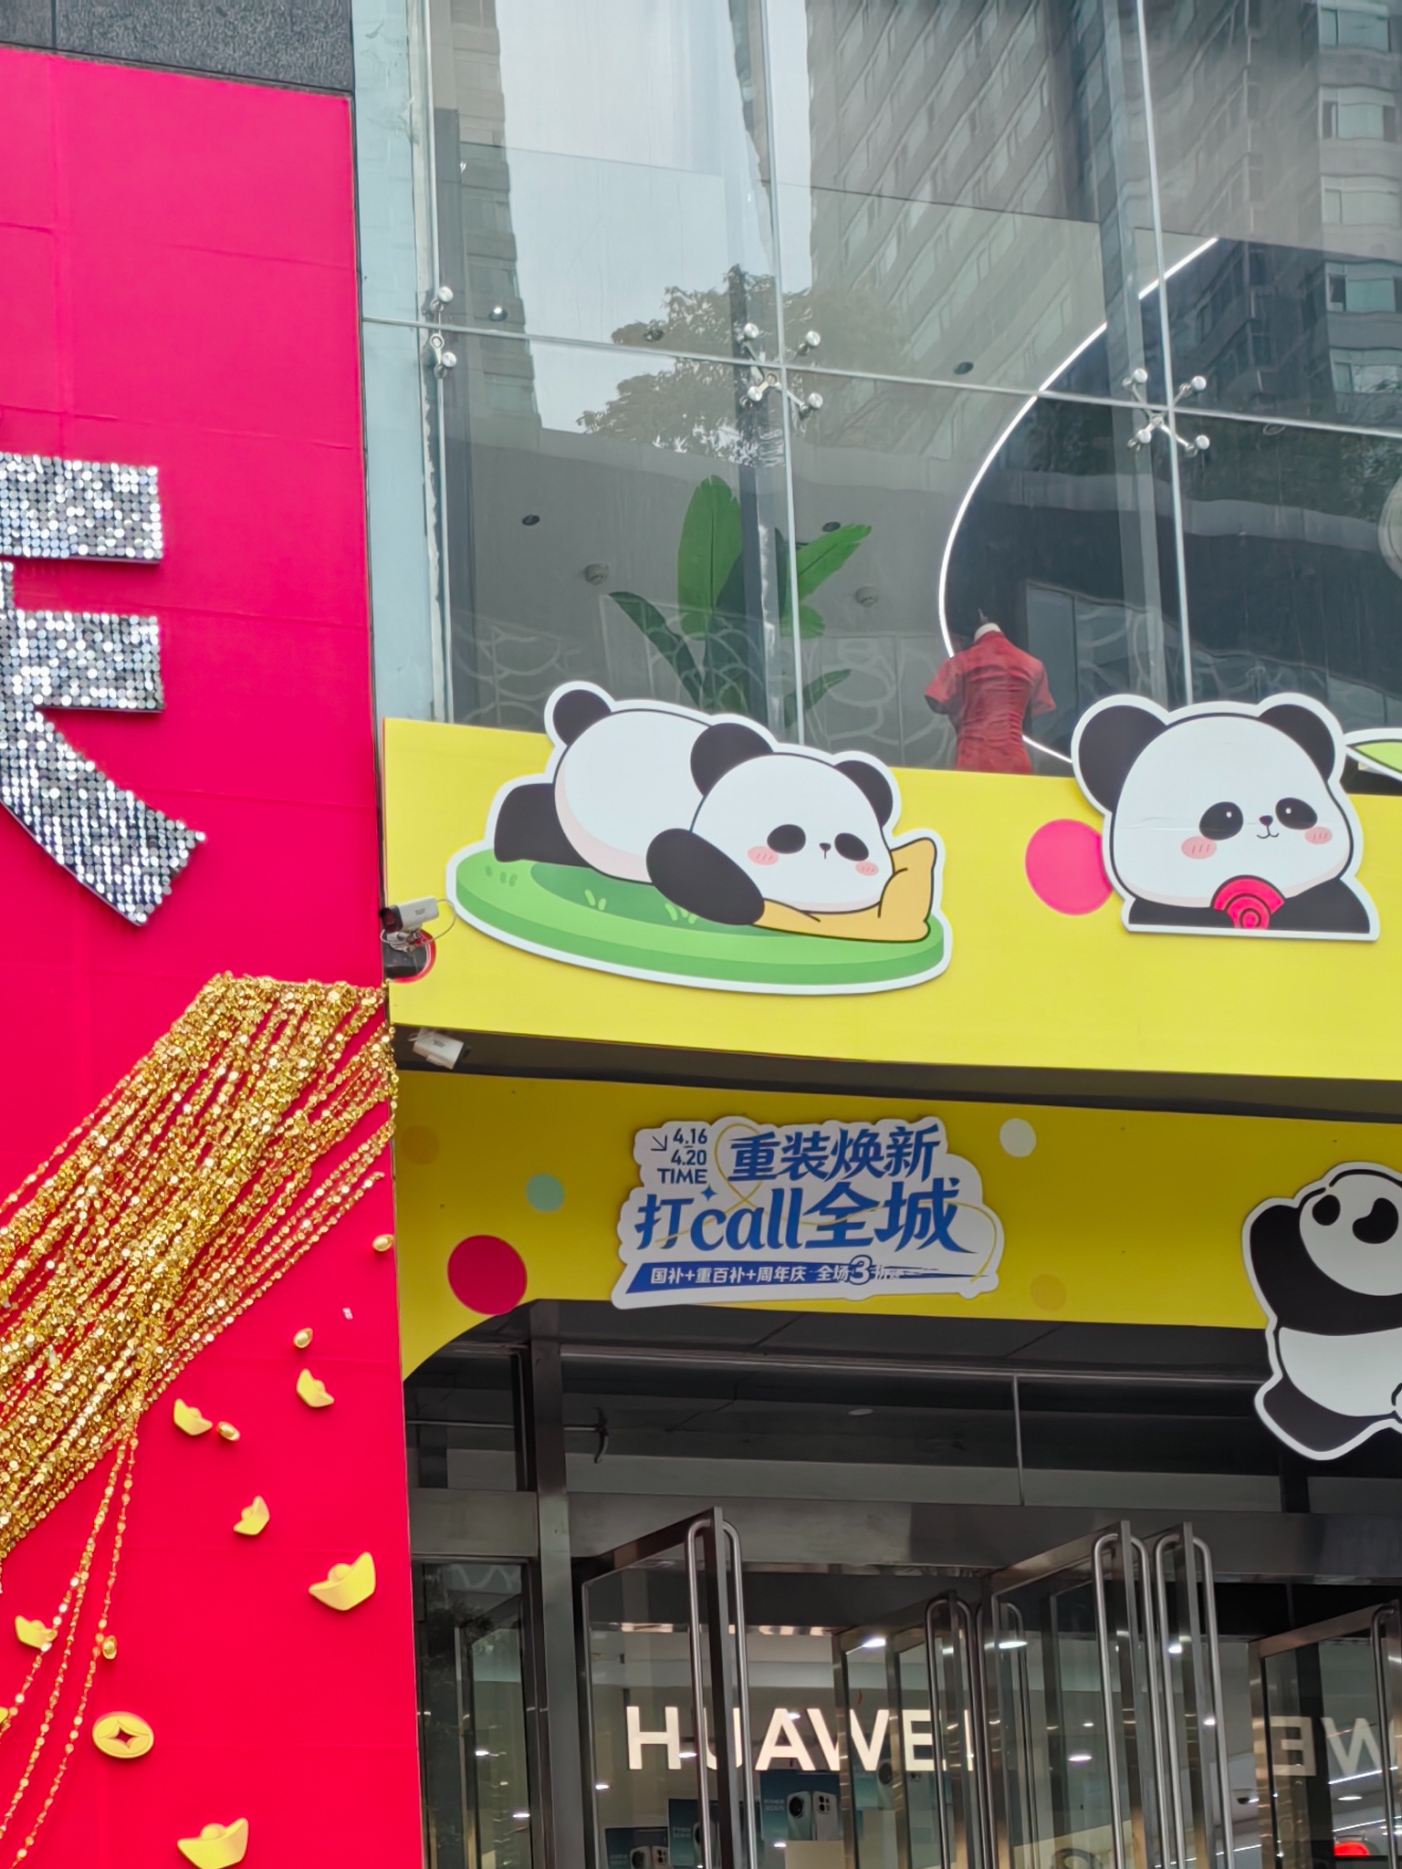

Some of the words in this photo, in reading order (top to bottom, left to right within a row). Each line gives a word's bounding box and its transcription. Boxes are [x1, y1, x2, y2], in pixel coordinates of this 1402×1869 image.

[673, 1128, 708, 1144] 4.16
[670, 1149, 707, 1166] 4.20
[728, 1123, 941, 1183] 重装焕新
[657, 1168, 708, 1184] TIME
[634, 1177, 978, 1253] 打call全城
